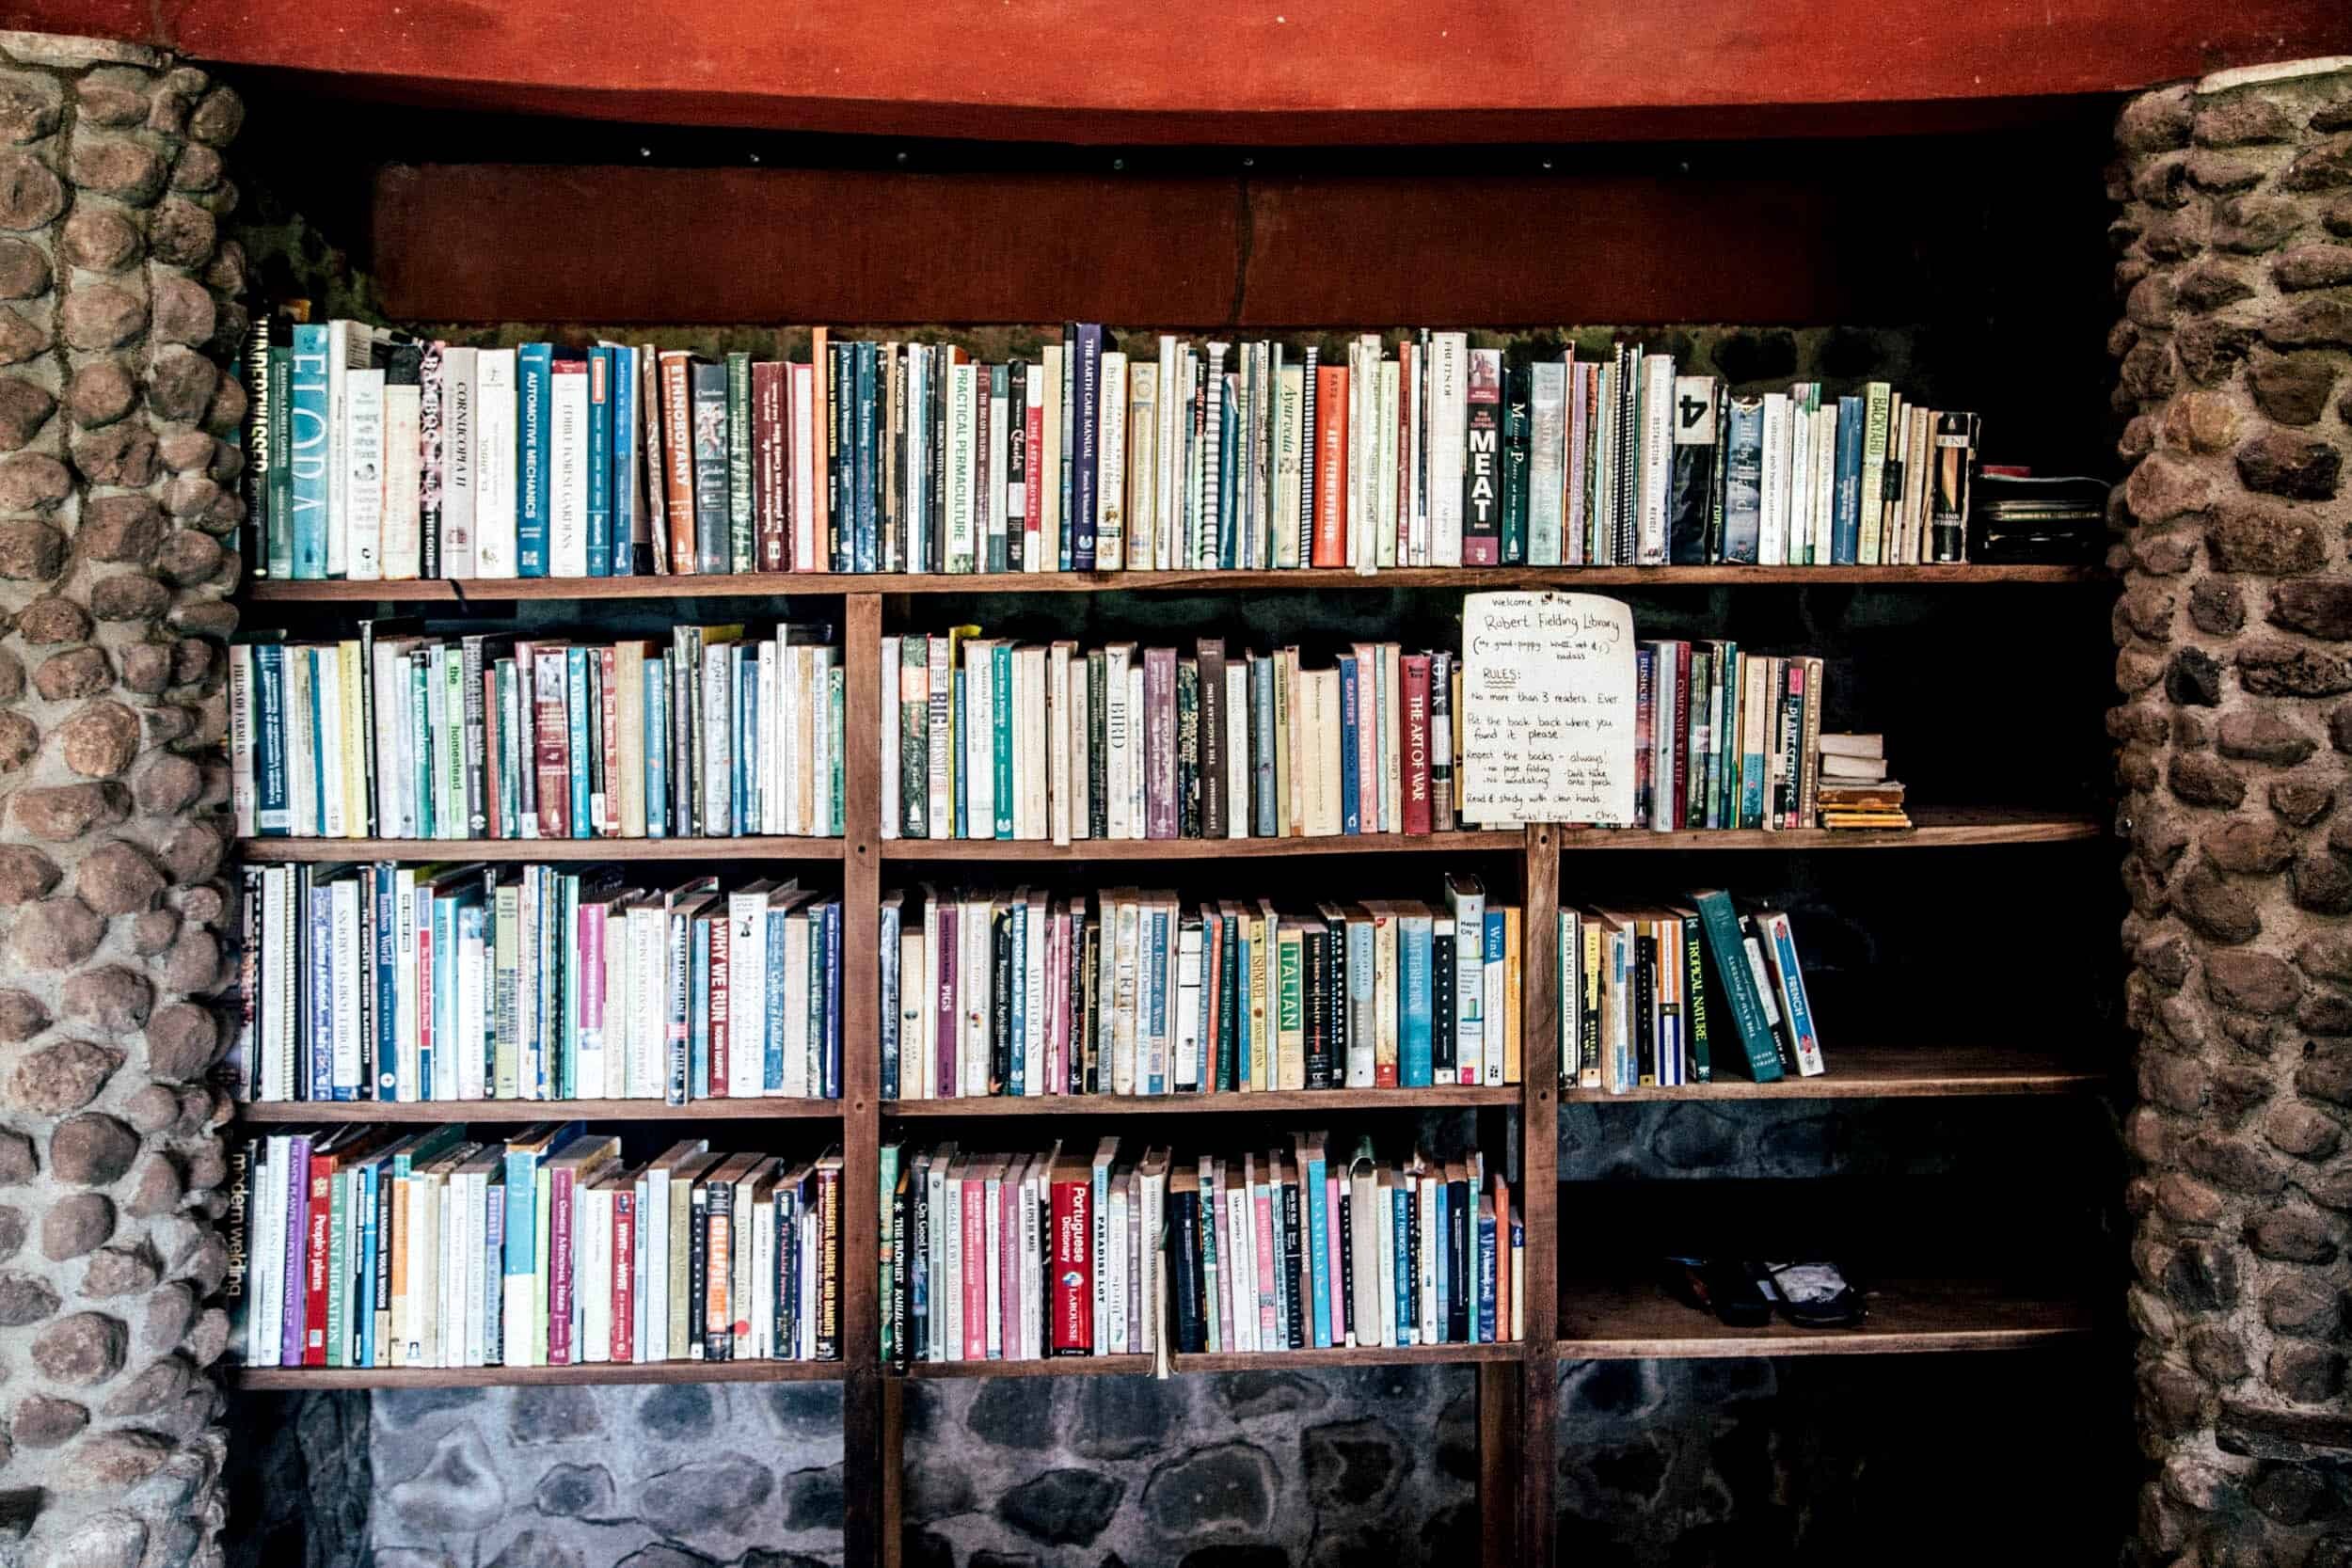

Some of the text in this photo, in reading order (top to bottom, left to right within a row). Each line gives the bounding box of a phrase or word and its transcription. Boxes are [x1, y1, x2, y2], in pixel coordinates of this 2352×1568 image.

[672, 364, 689, 486] ETHNOBOTANY
[1083, 338, 1093, 458] THE EARTH CARE MANUAL
[1283, 385, 1297, 452] Ayurveda
[1870, 397, 1888, 455] BACKYARD
[456, 381, 467, 488] CORNUCOPIA II
[525, 372, 537, 518] AUTOMOTIVE MECHANICS
[954, 368, 968, 541] PRACTICAL PERMACULTURE
[1651, 417, 1661, 466] DESTRUCTION
[563, 404, 573, 549] EDIBLE FOREST GARDENS
[1325, 430, 1337, 540] ART FERMENTATION
[1470, 430, 1497, 522] MEAT
[1712, 504, 1723, 525] run
[1485, 613, 1620, 641] Robert Fielding Library
[1492, 598, 1533, 607] Welcome
[1557, 597, 1571, 607] the
[1431, 662, 1447, 707] OAK
[1484, 669, 1521, 680] RULES:
[1518, 692, 1538, 702] than
[1542, 693, 1549, 703] 3
[1640, 658, 1648, 721] BUSHCRAFT
[233, 664, 246, 755] FIELDS OF FARMERS
[451, 666, 461, 790] the homestead
[571, 675, 583, 776] RAISING DUCKS
[930, 692, 947, 776] BIG NECESSITY
[1111, 702, 1125, 749] BIRD
[1474, 729, 1498, 740] found
[1508, 729, 1516, 739] it
[1487, 714, 1501, 725] the
[1538, 716, 1560, 726] back
[1565, 717, 1590, 727] where
[1597, 716, 1612, 732] you
[1676, 679, 1685, 738] COMPANIES
[1411, 695, 1423, 800] THE ART OF WAR
[1467, 752, 1494, 761] Respect
[1503, 751, 1518, 761] the
[1529, 752, 1554, 762] books
[1676, 743, 1683, 756] WE
[1467, 792, 1486, 802] Read
[1529, 793, 1547, 802] with
[1596, 811, 1618, 820] Chris
[361, 909, 370, 925] THE
[361, 927, 370, 971] COMPLETE
[380, 894, 392, 964] Bamboo World
[1489, 926, 1500, 958] Wind
[711, 925, 727, 1022] WHY WE RUN
[1014, 910, 1023, 1016] THE WOODLAND WAY
[1152, 914, 1164, 1035] Insect, Disease & Weed
[1252, 955, 1263, 1001] ISHMAEL
[1281, 946, 1298, 1027] ITALIAN
[1689, 939, 1708, 1041] TROPICAL NATURE
[1787, 975, 1804, 1016] FRENCH
[941, 985, 952, 1011] PIGS
[996, 959, 1008, 1047] Restoration Agriculture
[1030, 966, 1040, 1060] ADAPTOGENS
[1565, 1001, 1574, 1023] SAVED
[362, 1011, 371, 1064] BLACKSMITH
[228, 1152, 246, 1296] modern welding
[311, 1213, 326, 1291] People's plants
[918, 1203, 928, 1273] On Good Land
[1060, 1216, 1072, 1262] Dictionary
[1070, 1187, 1086, 1263] Portuguese
[328, 1213, 342, 1344] PLANT MIGRATION
[824, 1181, 835, 1336] INSURGENTS, RAIDERS, AND BANDITS
[1068, 1288, 1078, 1341] LAROUSSE
